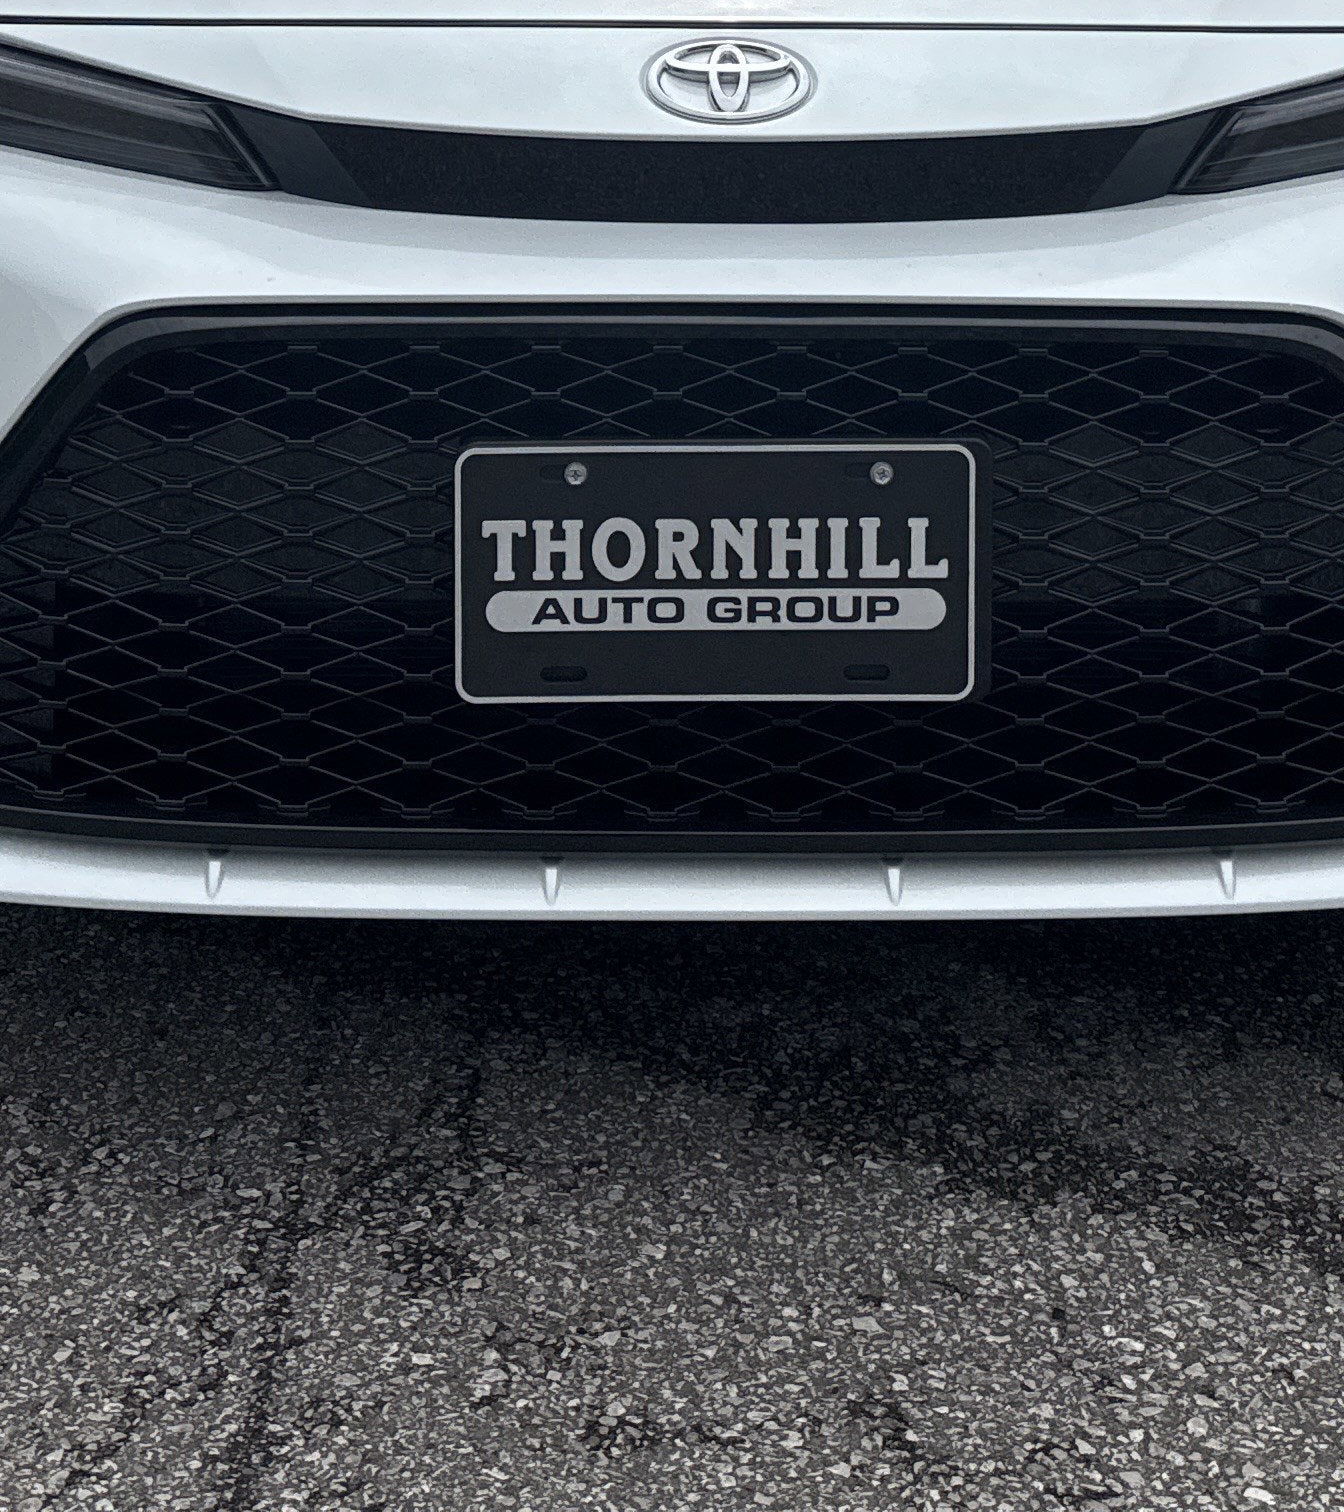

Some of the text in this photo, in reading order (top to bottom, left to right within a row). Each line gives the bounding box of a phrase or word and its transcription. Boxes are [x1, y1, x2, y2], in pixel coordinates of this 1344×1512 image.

[481, 517, 949, 582] THORNHILL
[531, 595, 900, 626] AUTO GROUP
